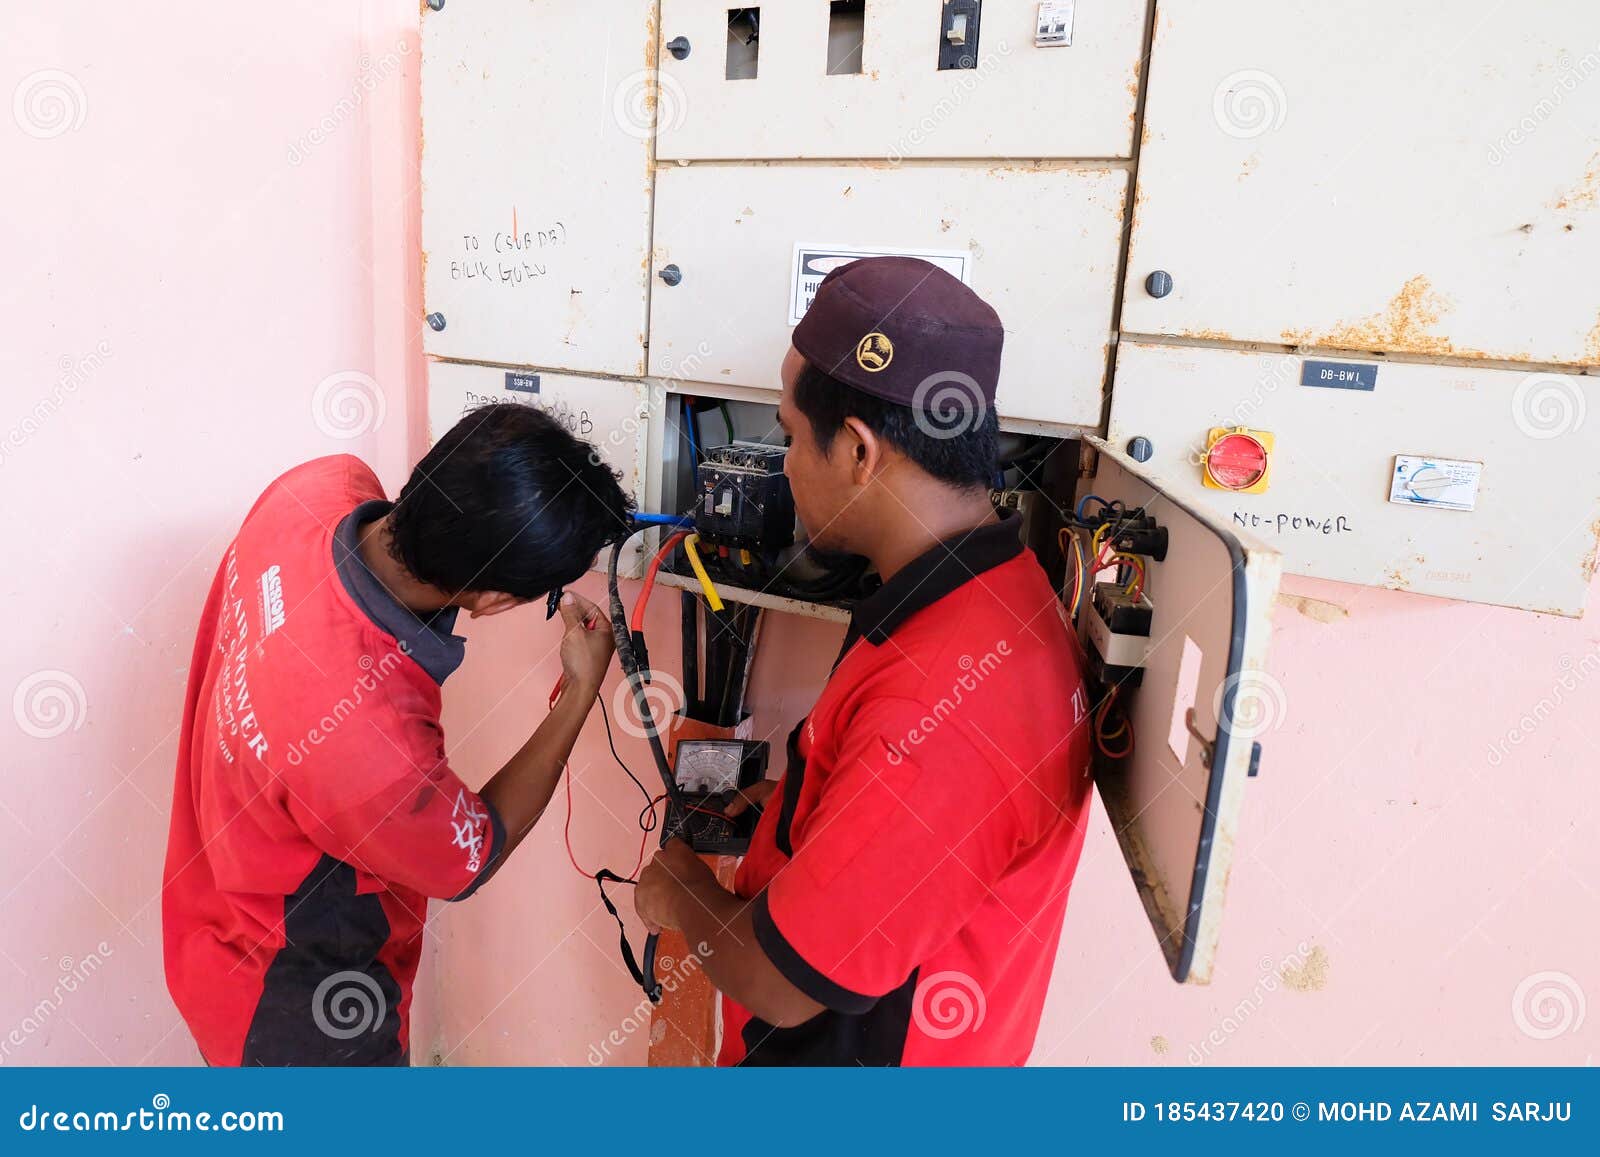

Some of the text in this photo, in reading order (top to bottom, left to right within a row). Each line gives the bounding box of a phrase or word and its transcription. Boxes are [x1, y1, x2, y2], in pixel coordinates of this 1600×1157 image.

[463, 235, 479, 251] TO
[451, 261, 493, 281] BILIK
[234, 644, 270, 761] POWER
